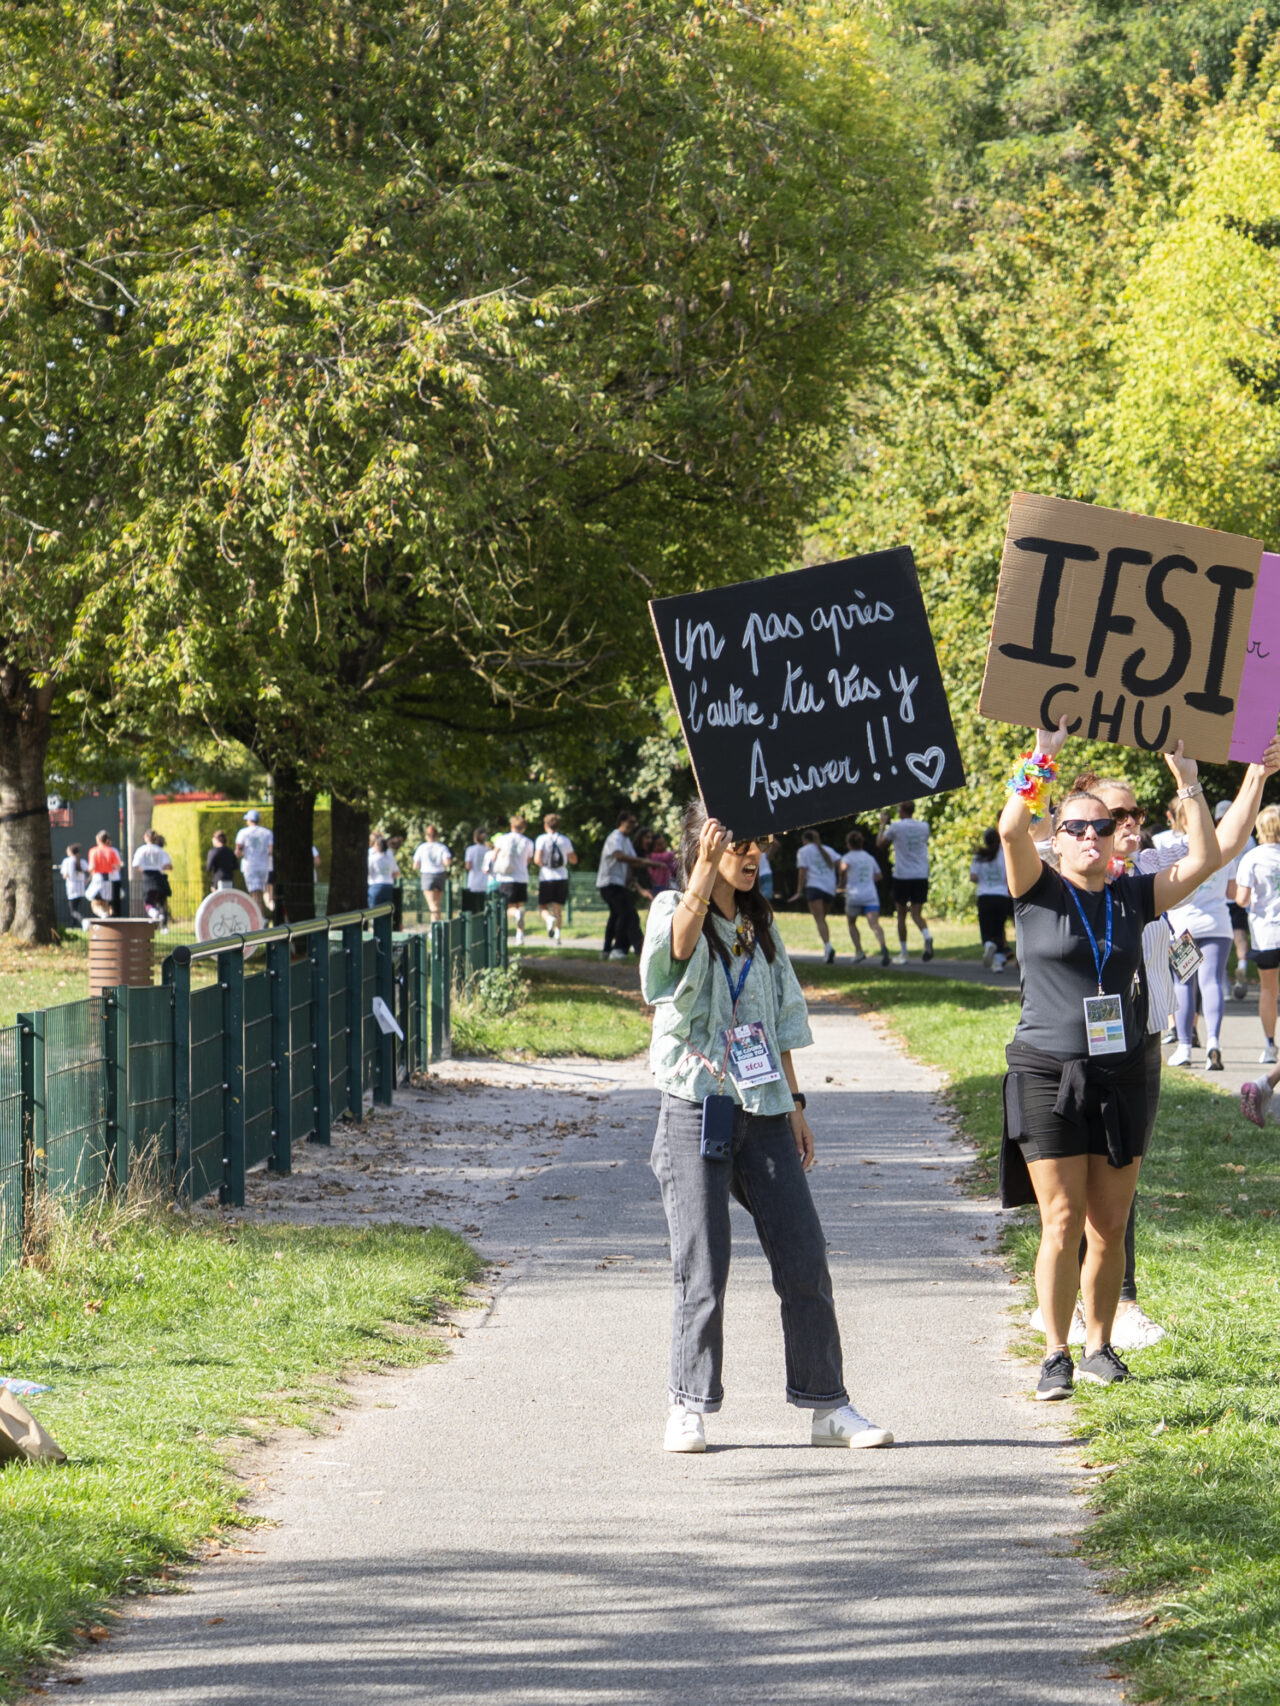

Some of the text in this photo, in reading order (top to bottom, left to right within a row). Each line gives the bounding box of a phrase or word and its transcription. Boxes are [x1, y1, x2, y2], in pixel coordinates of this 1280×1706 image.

[675, 589, 895, 676] Un pas après
[998, 537, 1254, 716] IFSI
[781, 660, 825, 714] tu
[888, 665, 919, 723] y
[1040, 682, 1171, 751] CHU
